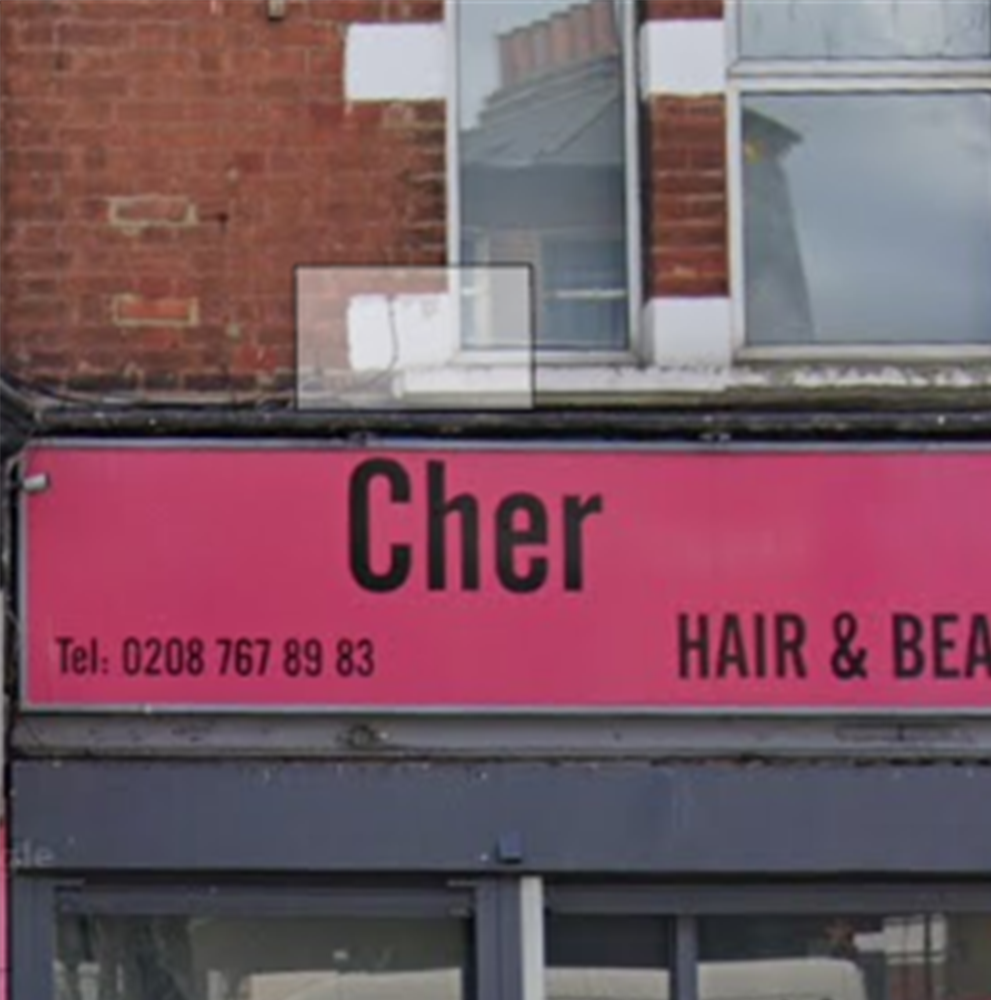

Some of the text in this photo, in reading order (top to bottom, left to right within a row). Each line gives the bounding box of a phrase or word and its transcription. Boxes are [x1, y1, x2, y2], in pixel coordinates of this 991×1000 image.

[348, 457, 603, 594] Cher
[56, 637, 375, 677] Tel: 0208 767 89 83
[677, 612, 808, 680] HAIR
[830, 612, 868, 680] &
